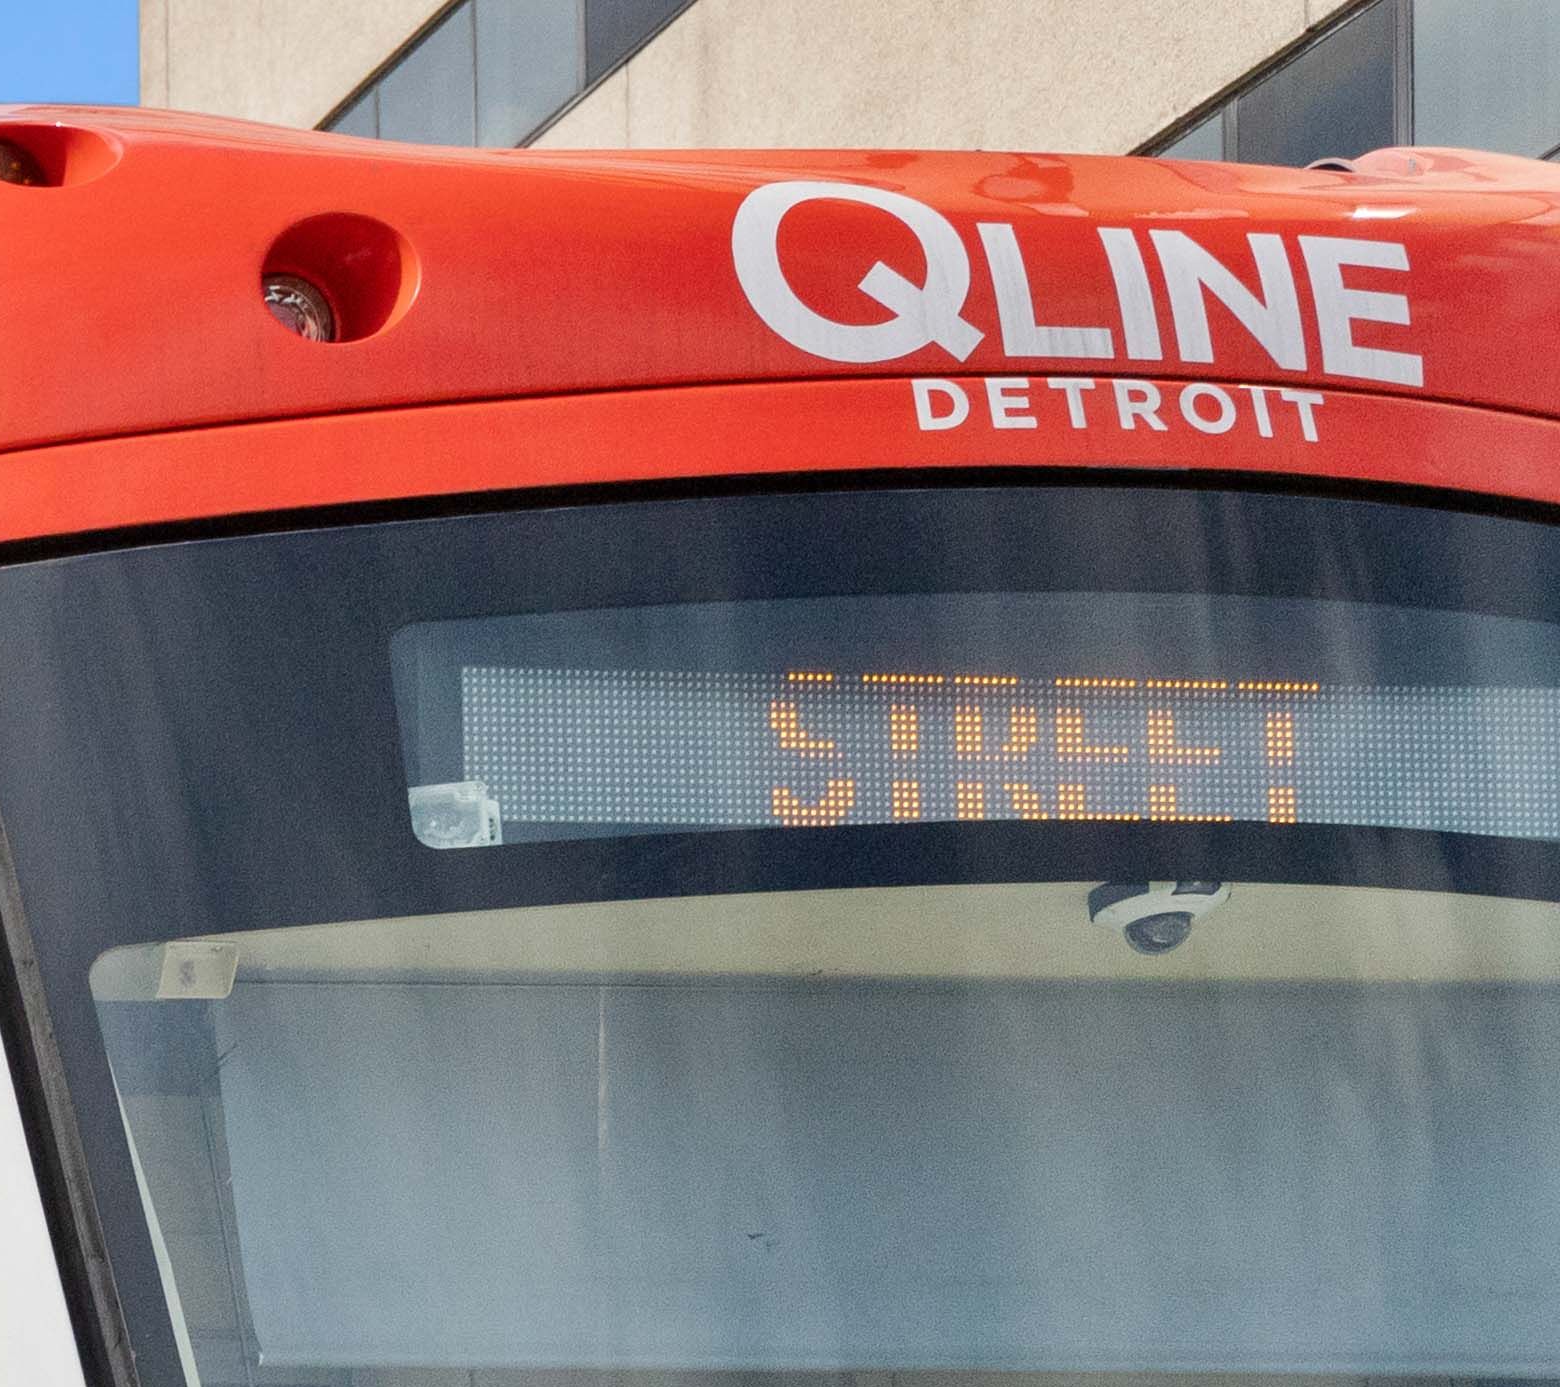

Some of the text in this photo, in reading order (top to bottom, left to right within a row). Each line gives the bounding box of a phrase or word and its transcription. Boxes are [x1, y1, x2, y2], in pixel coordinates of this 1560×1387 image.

[729, 179, 1424, 389] QLINE
[911, 377, 1325, 442] DETROIT
[769, 670, 1321, 827] STREET
